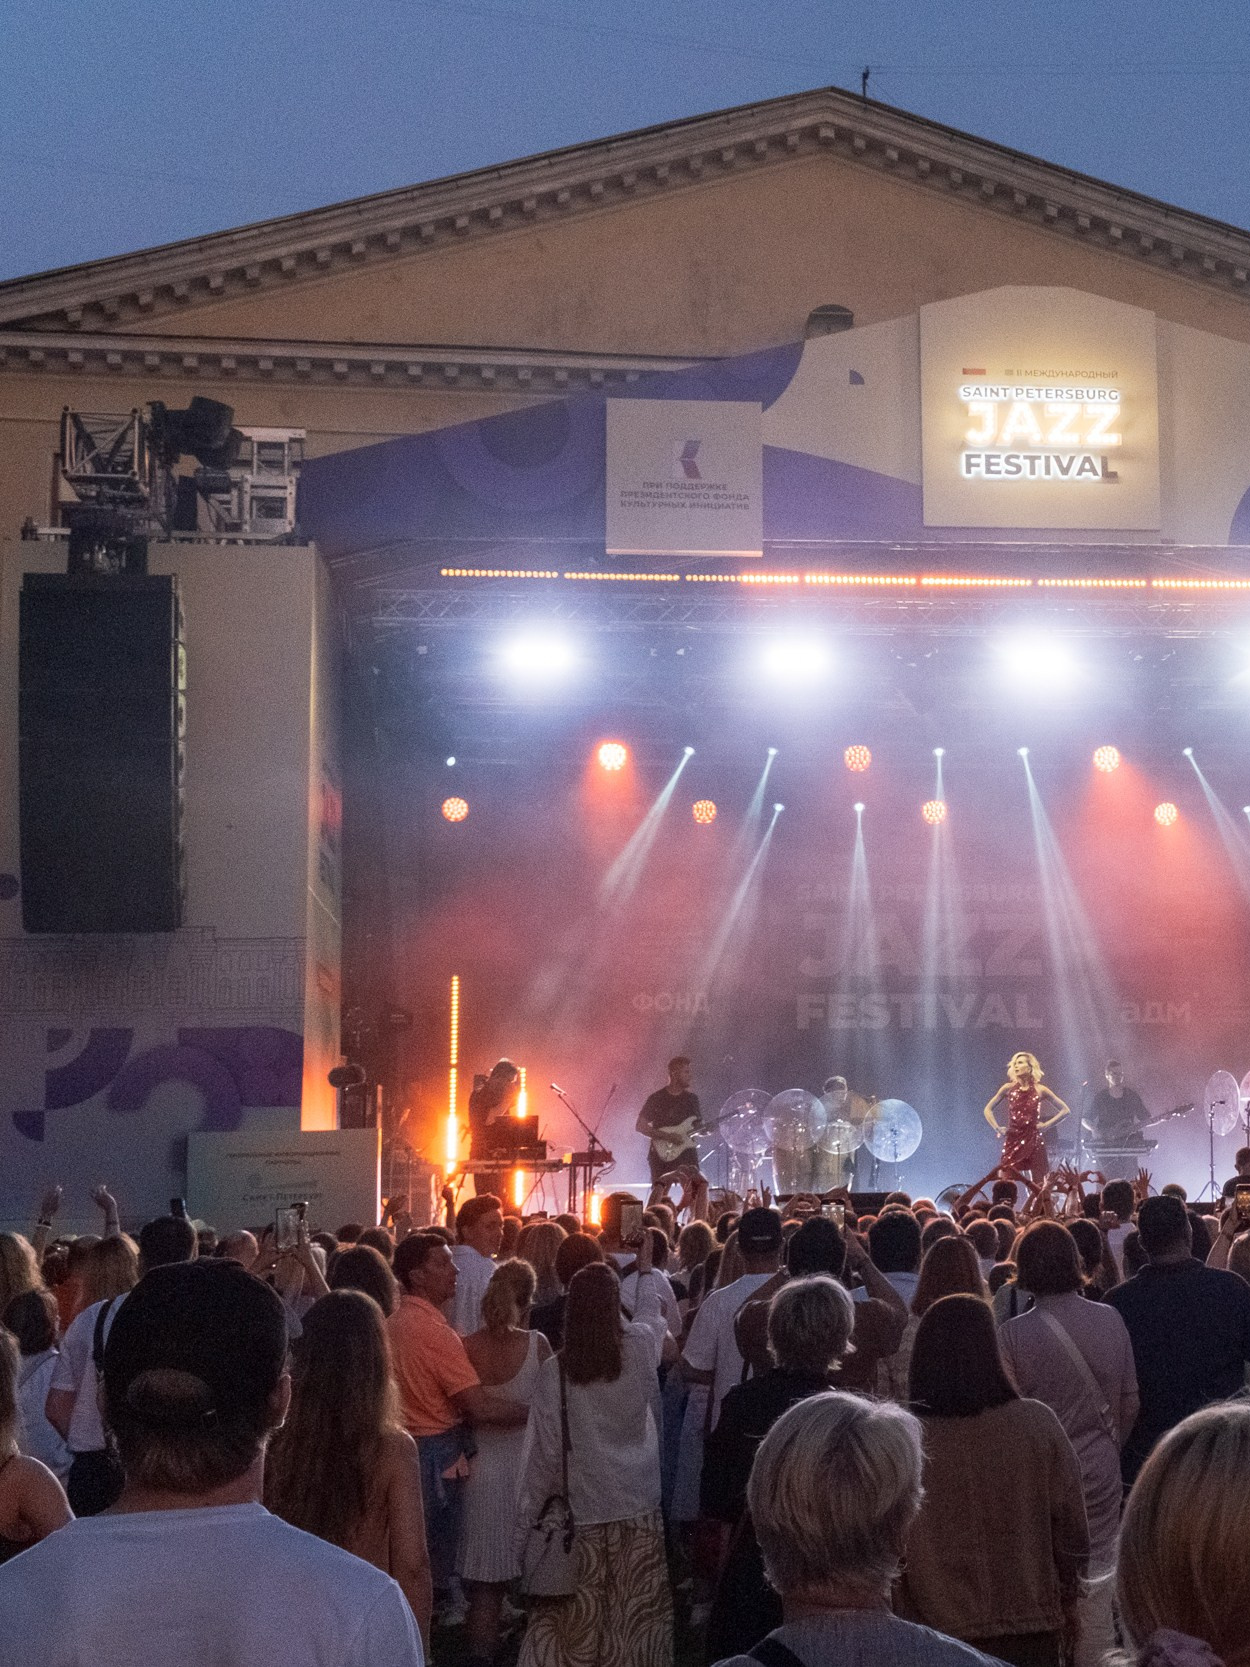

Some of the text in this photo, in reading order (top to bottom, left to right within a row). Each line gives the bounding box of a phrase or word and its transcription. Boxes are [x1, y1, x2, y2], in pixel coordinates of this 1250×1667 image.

[1024, 370, 1119, 379] МЕЖДУНАРОДНЫЙ
[962, 386, 1120, 401] SAINT PETERSBURG
[963, 402, 1123, 449] JAZZ
[964, 452, 1119, 479] FESTIVAL
[642, 481, 728, 491] ПРИ ПОДДЕРЖКЕ
[620, 490, 750, 502] ПРЕЗИДЕНТСКОГО ФОНДА
[620, 500, 687, 509] КУЛЬТУРНЫХ
[797, 912, 1043, 978] JAZZ
[795, 992, 1044, 1030] FESTIVAL
